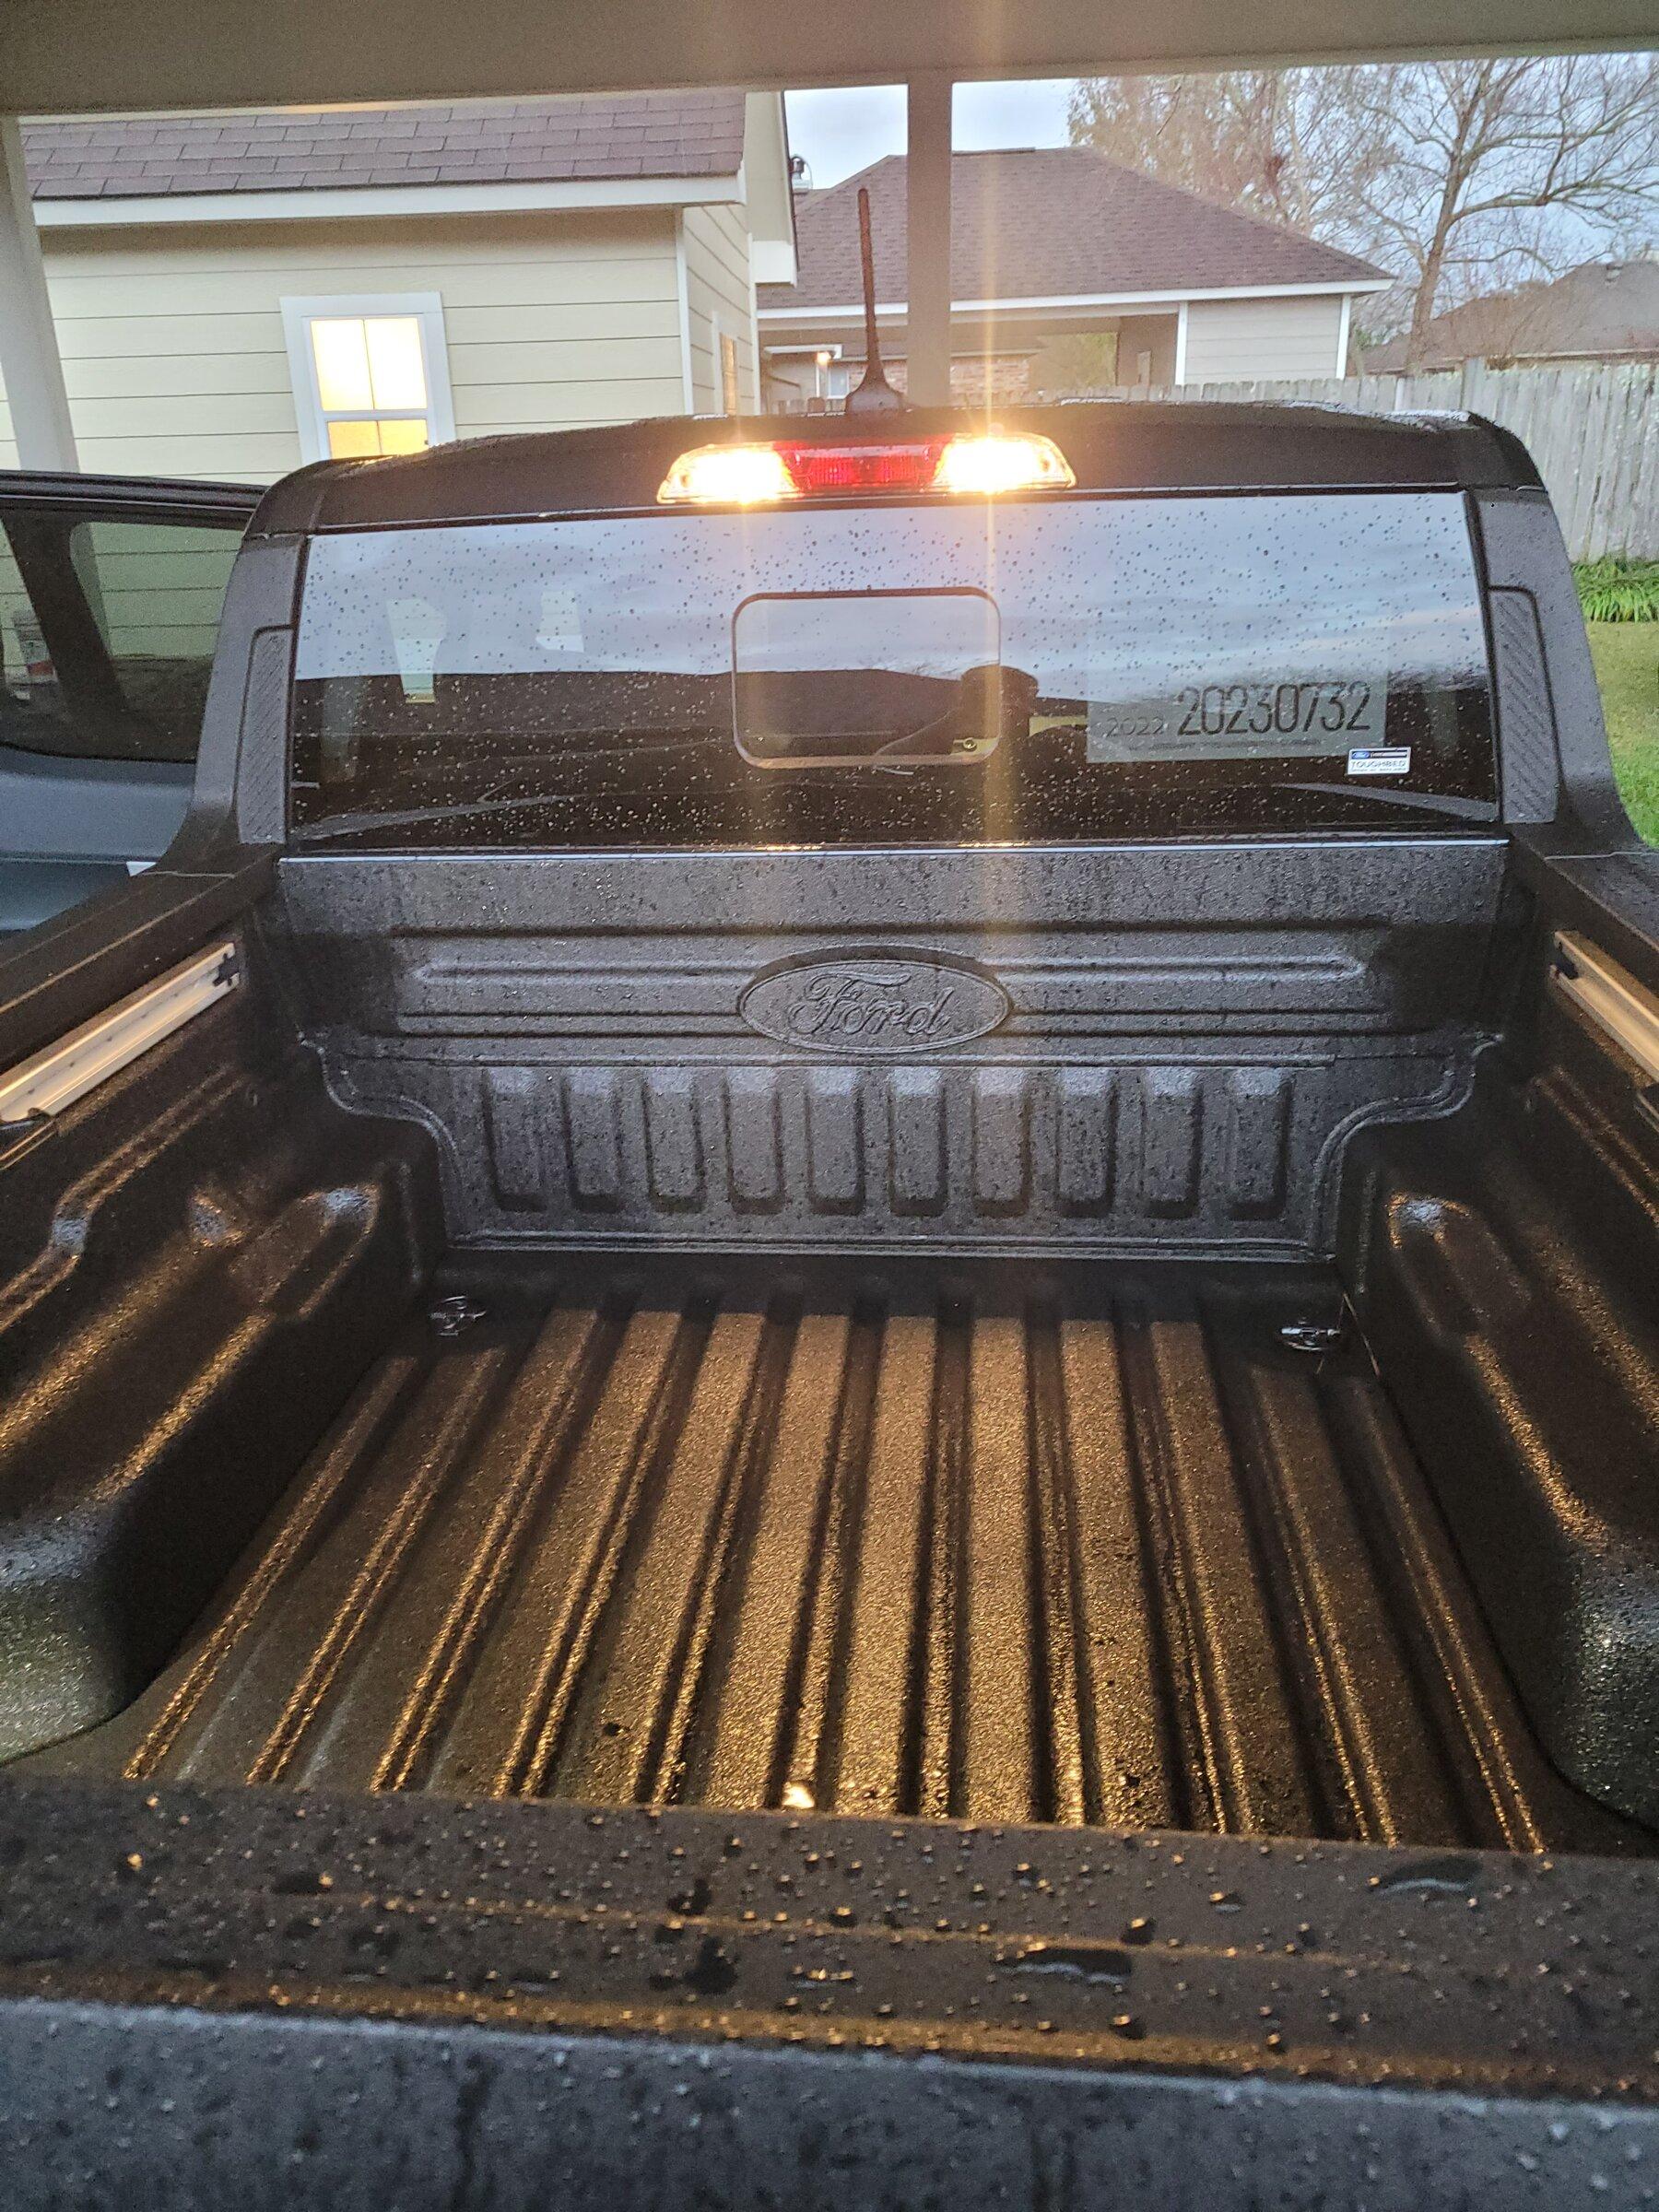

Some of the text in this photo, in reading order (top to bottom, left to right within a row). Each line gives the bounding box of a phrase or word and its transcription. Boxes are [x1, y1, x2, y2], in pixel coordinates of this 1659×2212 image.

[1105, 681, 1371, 737] 2022 20230732
[786, 972, 956, 1035] Ford
